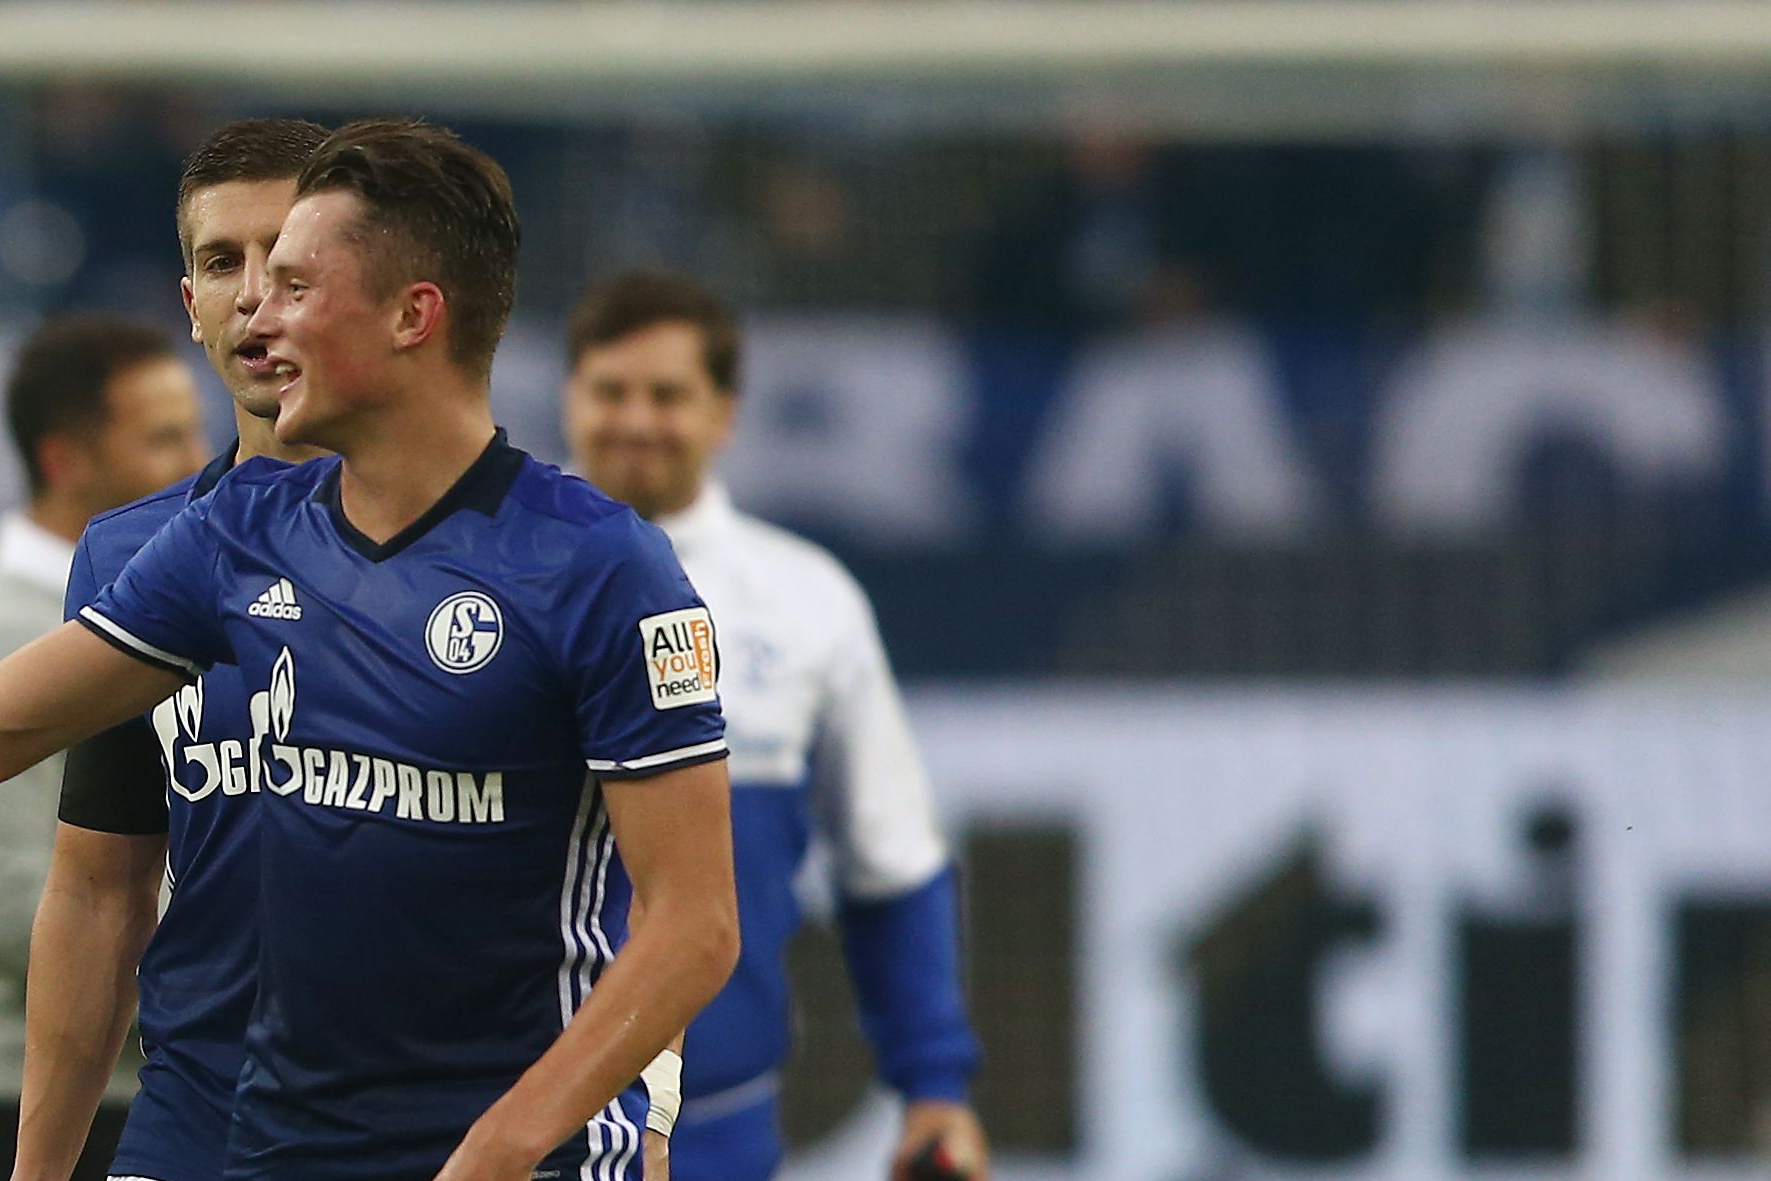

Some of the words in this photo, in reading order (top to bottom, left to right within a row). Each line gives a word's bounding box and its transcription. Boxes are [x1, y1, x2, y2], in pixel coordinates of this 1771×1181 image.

[248, 601, 301, 620] adidas
[652, 621, 693, 658] All
[652, 653, 697, 682] you
[656, 671, 701, 698] need
[303, 747, 505, 823] GAZPROM
